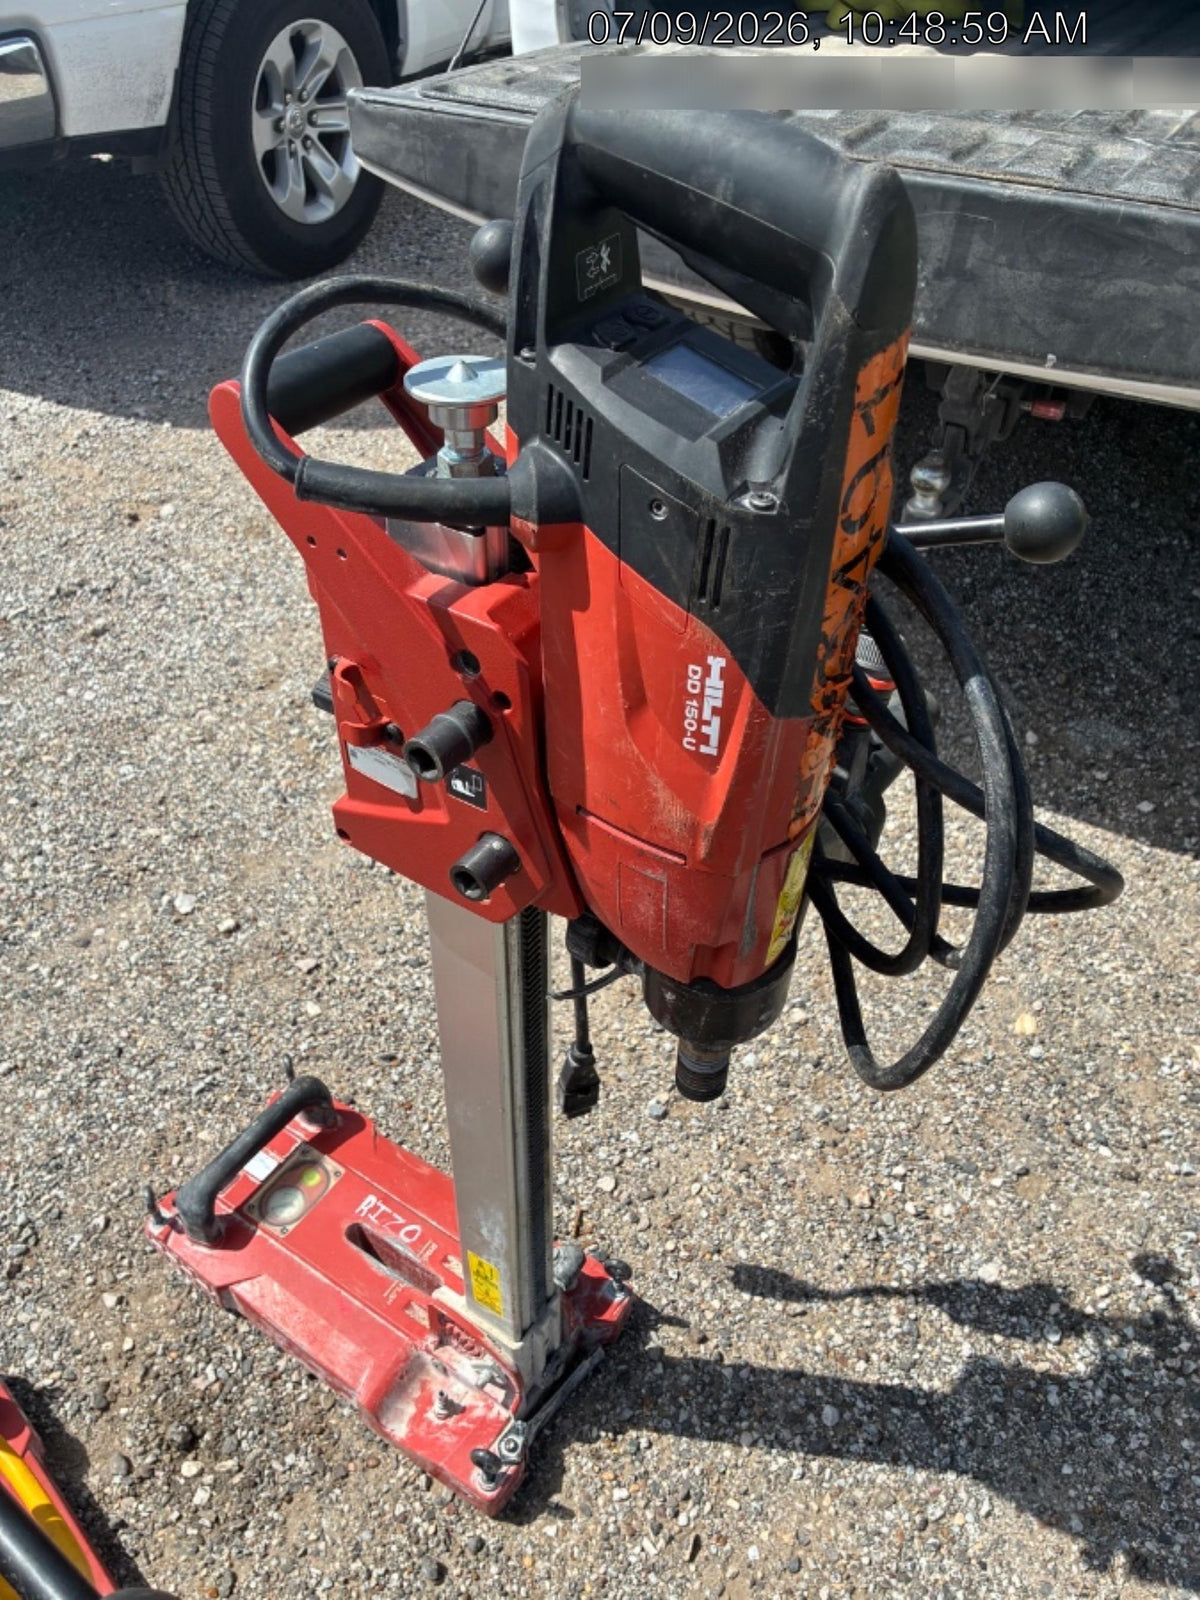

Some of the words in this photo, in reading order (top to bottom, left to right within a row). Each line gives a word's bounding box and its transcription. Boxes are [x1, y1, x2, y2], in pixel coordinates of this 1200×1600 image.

[687, 664, 702, 694] DD
[682, 699, 699, 751] 150-U
[699, 655, 727, 756] HILTI
